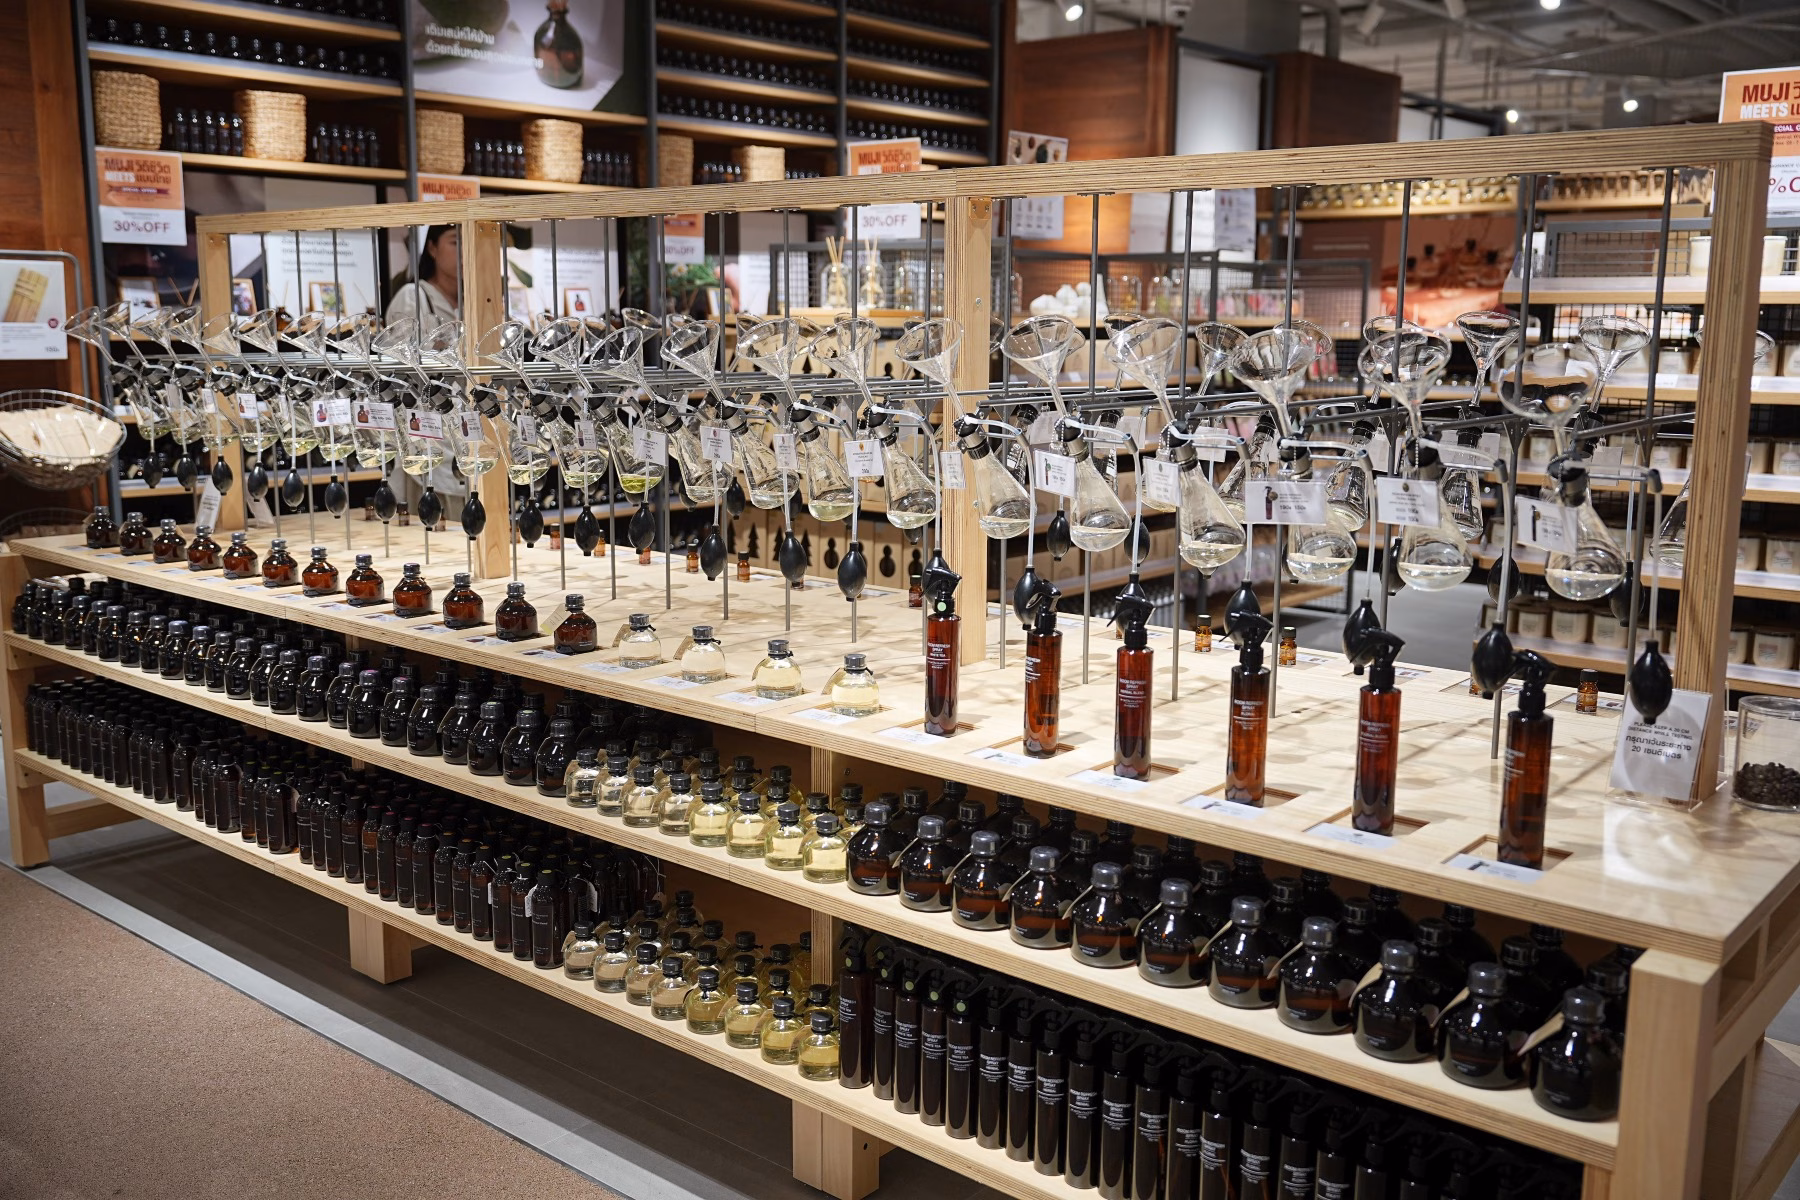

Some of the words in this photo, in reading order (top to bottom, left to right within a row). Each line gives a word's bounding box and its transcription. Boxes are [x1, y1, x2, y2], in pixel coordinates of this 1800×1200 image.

[1742, 82, 1791, 103] MUJI
[1740, 102, 1789, 120] MEETS
[1774, 124, 1794, 133] ECIAL
[104, 158, 135, 171] MUJI
[114, 220, 171, 233] 30%OFF
[863, 215, 908, 228] 30%OFF
